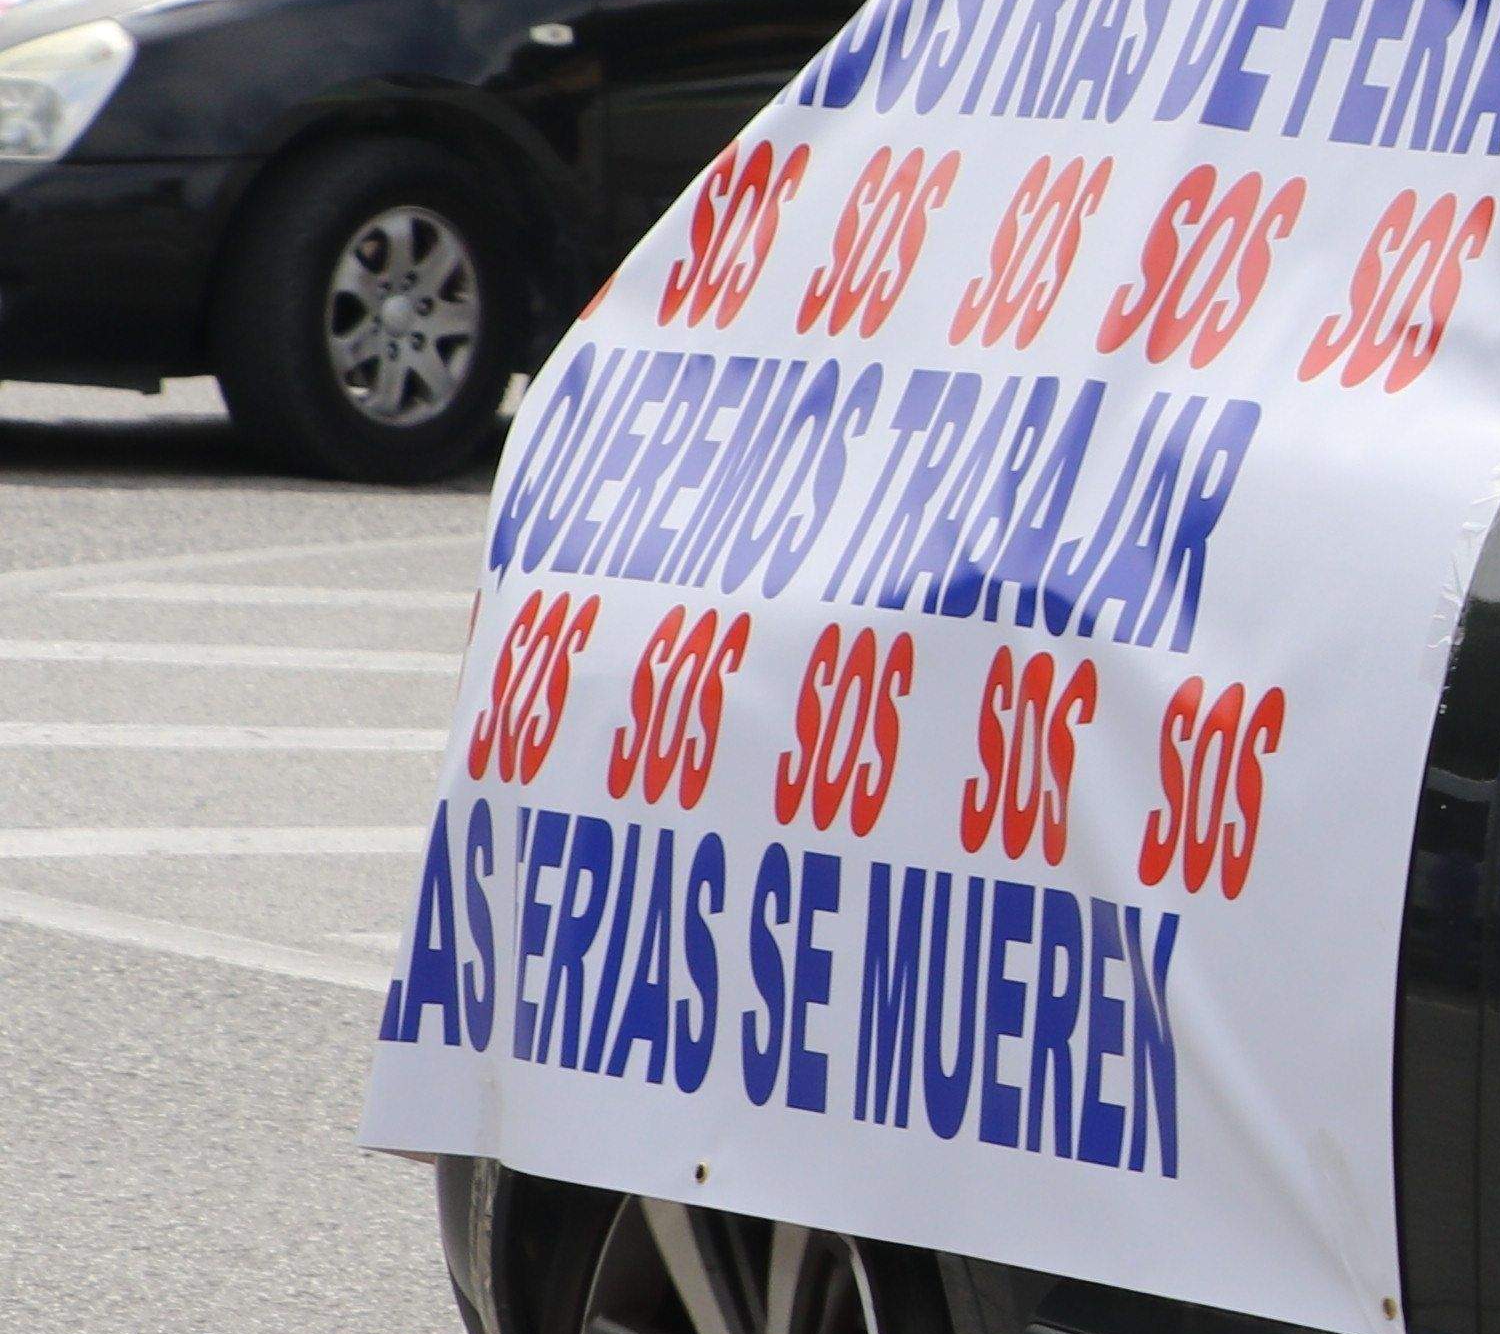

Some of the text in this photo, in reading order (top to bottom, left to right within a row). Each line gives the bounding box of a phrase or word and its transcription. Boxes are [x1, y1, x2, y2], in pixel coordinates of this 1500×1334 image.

[657, 140, 1496, 395] SOS SOS SOS SOS SOS
[488, 341, 1262, 653] QUEREMOS TRABAJAR
[468, 588, 1287, 902] SOS SOS SOS SOS SOS
[741, 840, 841, 1116] SE
[853, 860, 1179, 1179] MUEREN
